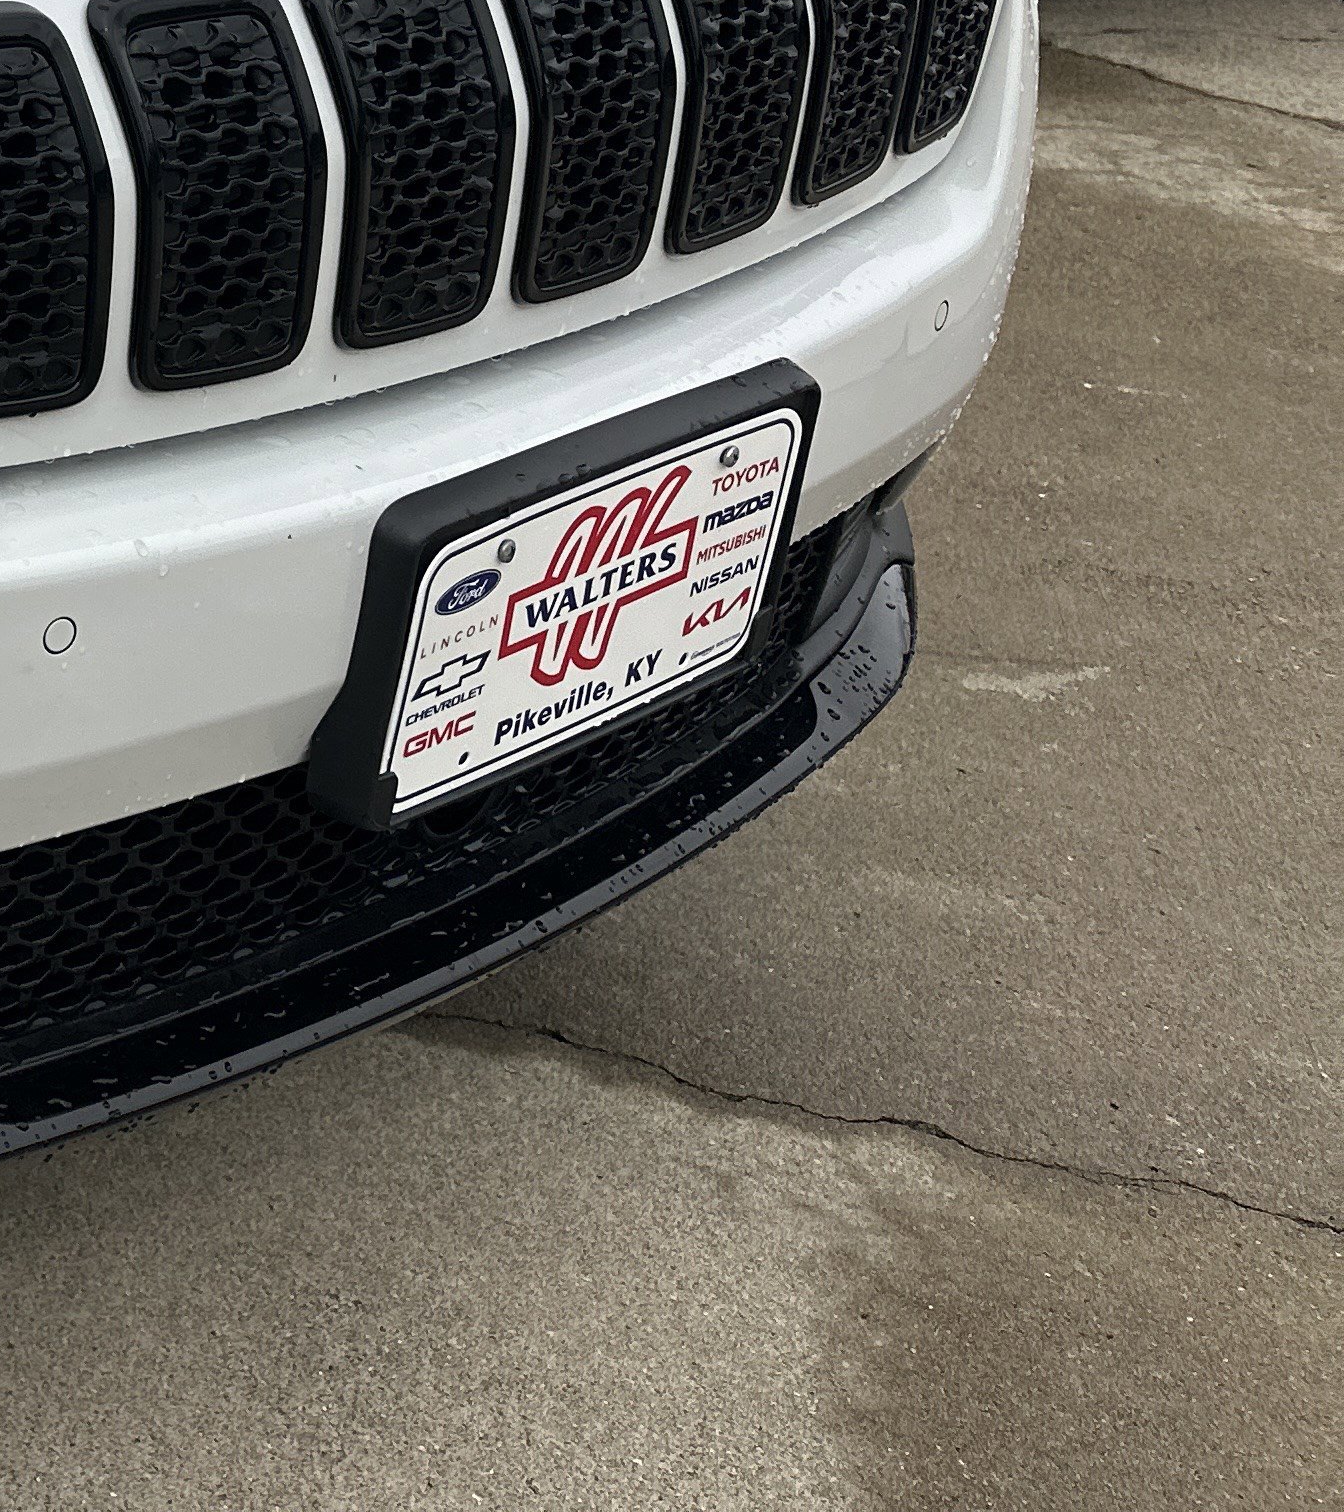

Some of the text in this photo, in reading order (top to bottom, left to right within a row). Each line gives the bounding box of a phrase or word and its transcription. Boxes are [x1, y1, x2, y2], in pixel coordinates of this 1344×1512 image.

[712, 456, 780, 497] TOYOTA
[696, 524, 767, 566] MITSUBISHI
[447, 577, 488, 610] Ford
[525, 542, 677, 628] WALTERS
[689, 555, 760, 598] NISSAN
[419, 614, 499, 660] LINCOLN
[405, 684, 486, 727] CHEVROLET
[494, 648, 663, 746] Pikeville, KY
[402, 711, 477, 758] GMC
